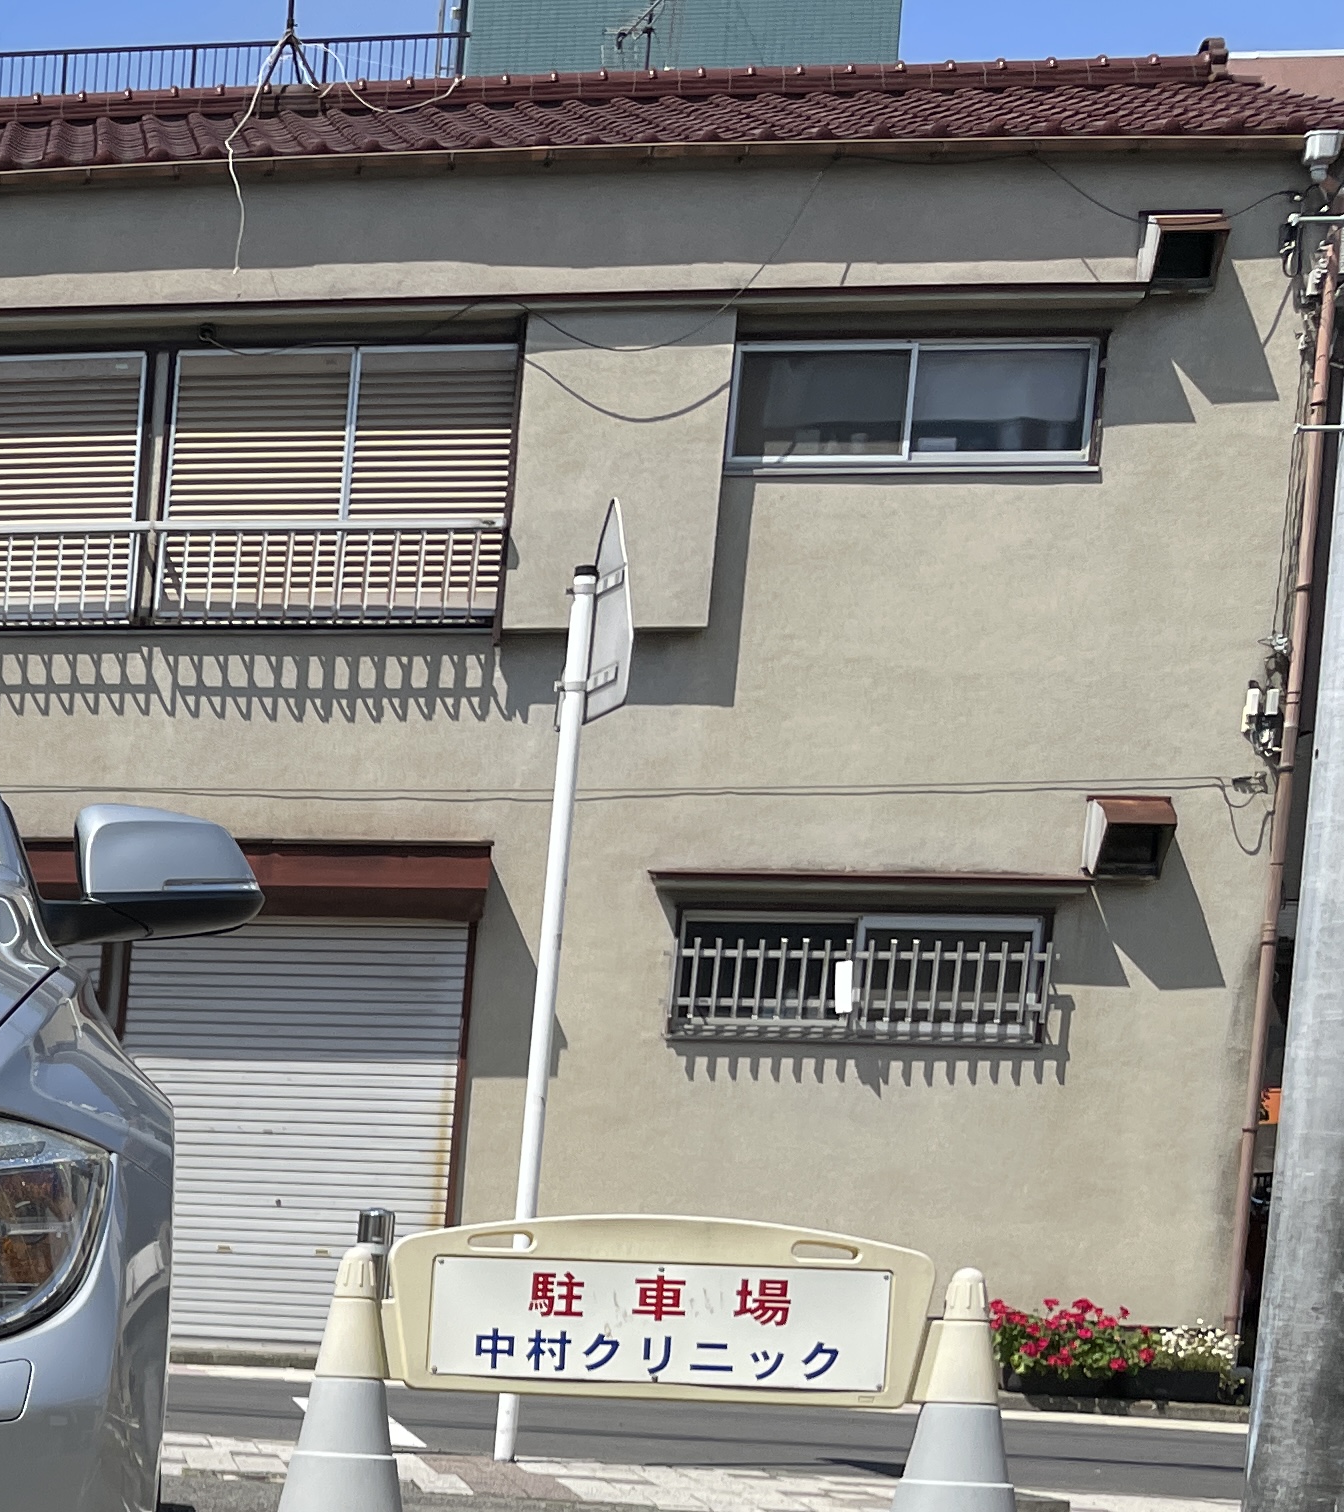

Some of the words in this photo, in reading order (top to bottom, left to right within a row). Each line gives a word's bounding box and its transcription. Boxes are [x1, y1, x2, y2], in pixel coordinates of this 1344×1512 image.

[529, 1272, 792, 1327] 駐車場
[475, 1329, 840, 1380] 中村クリニック
